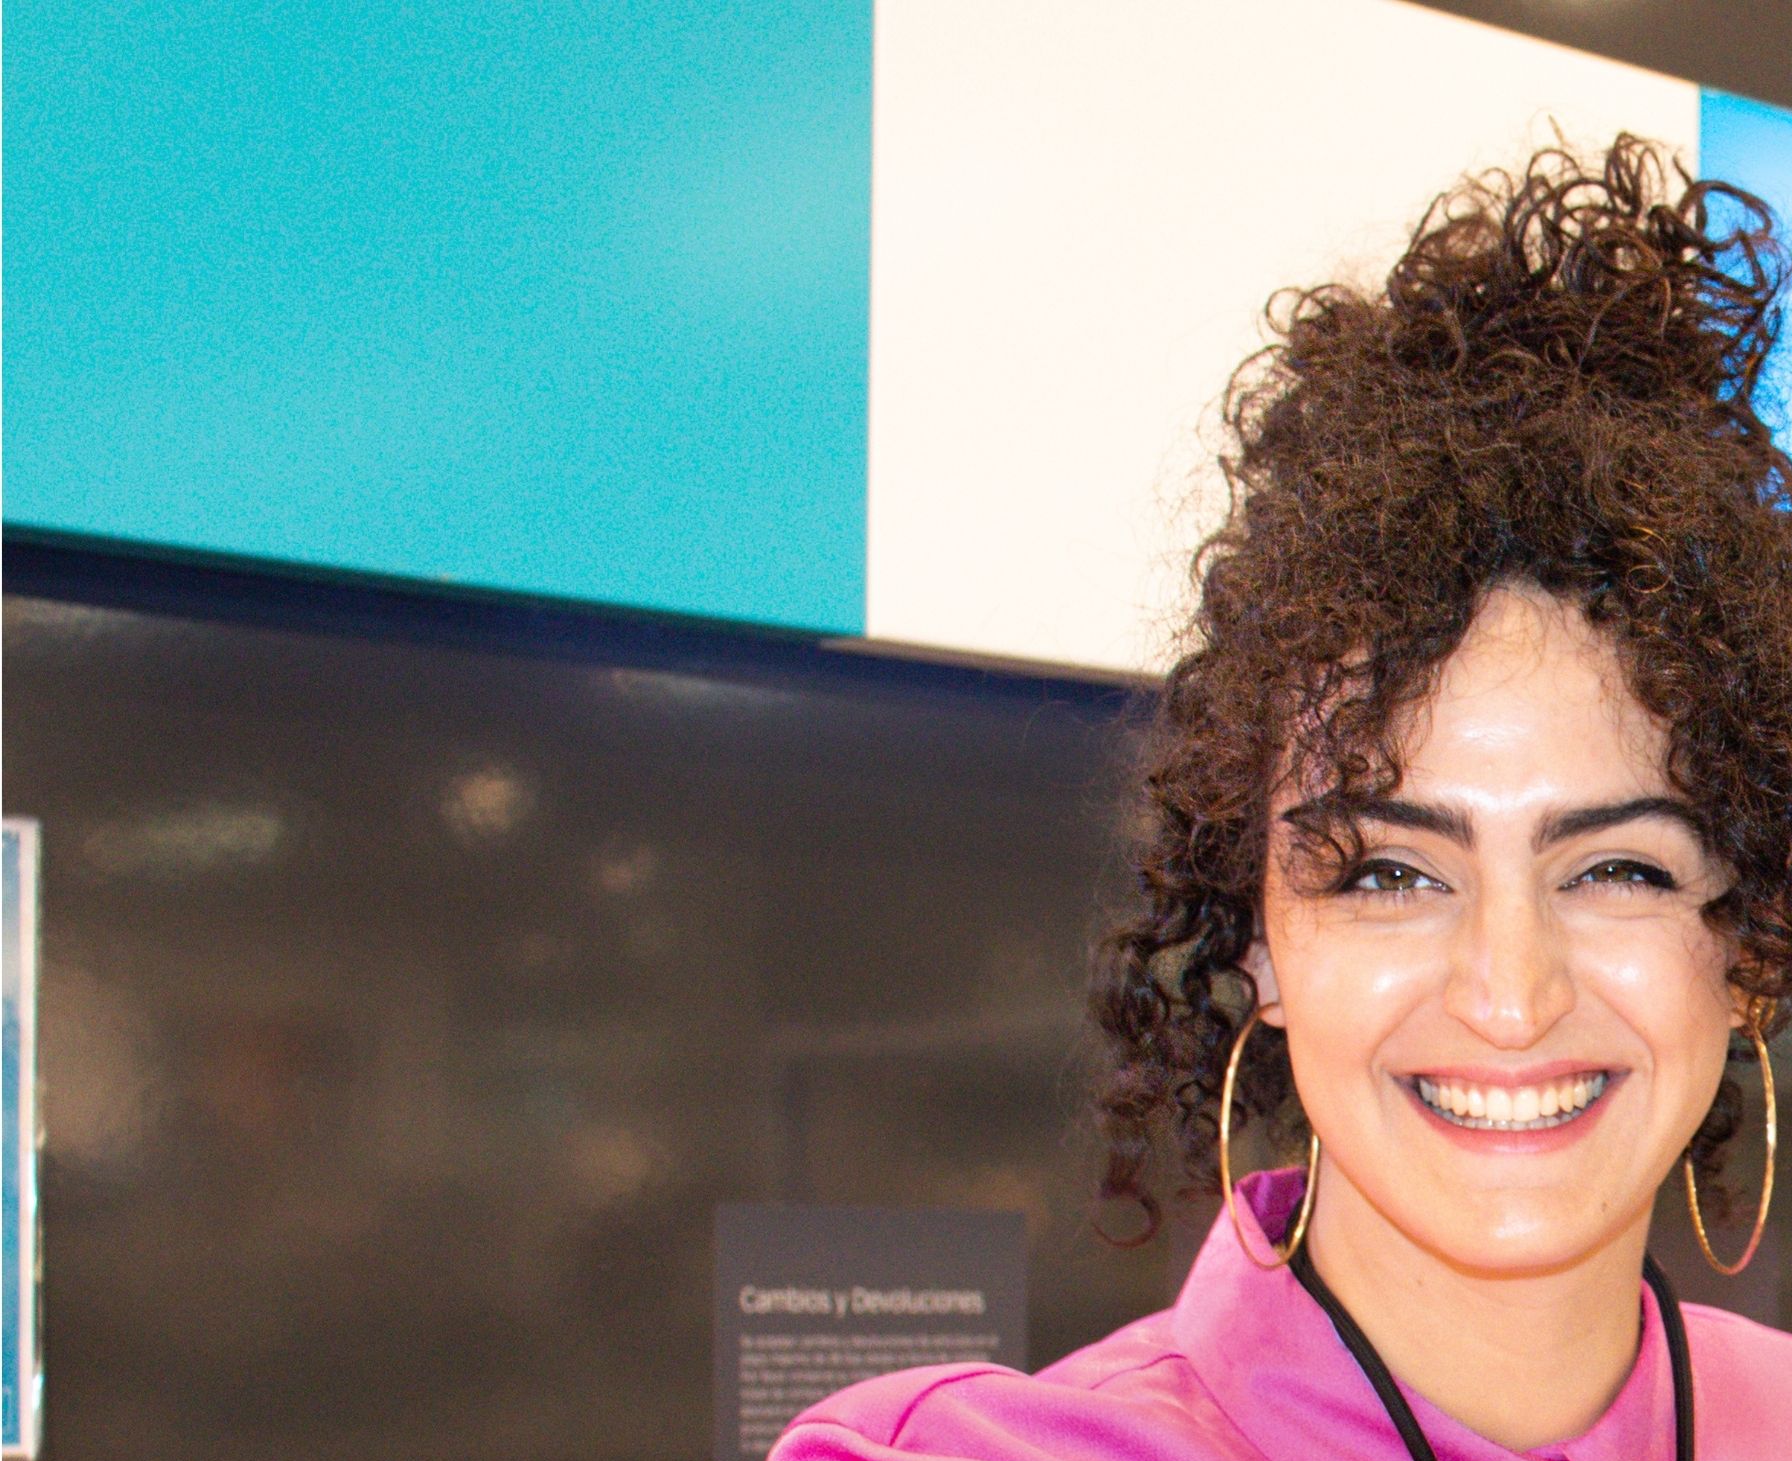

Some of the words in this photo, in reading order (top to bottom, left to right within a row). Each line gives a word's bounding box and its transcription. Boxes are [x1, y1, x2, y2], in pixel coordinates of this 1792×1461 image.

[740, 1285, 831, 1314] Cambios
[833, 1290, 848, 1319] y
[850, 1284, 985, 1315] Devoluciones
